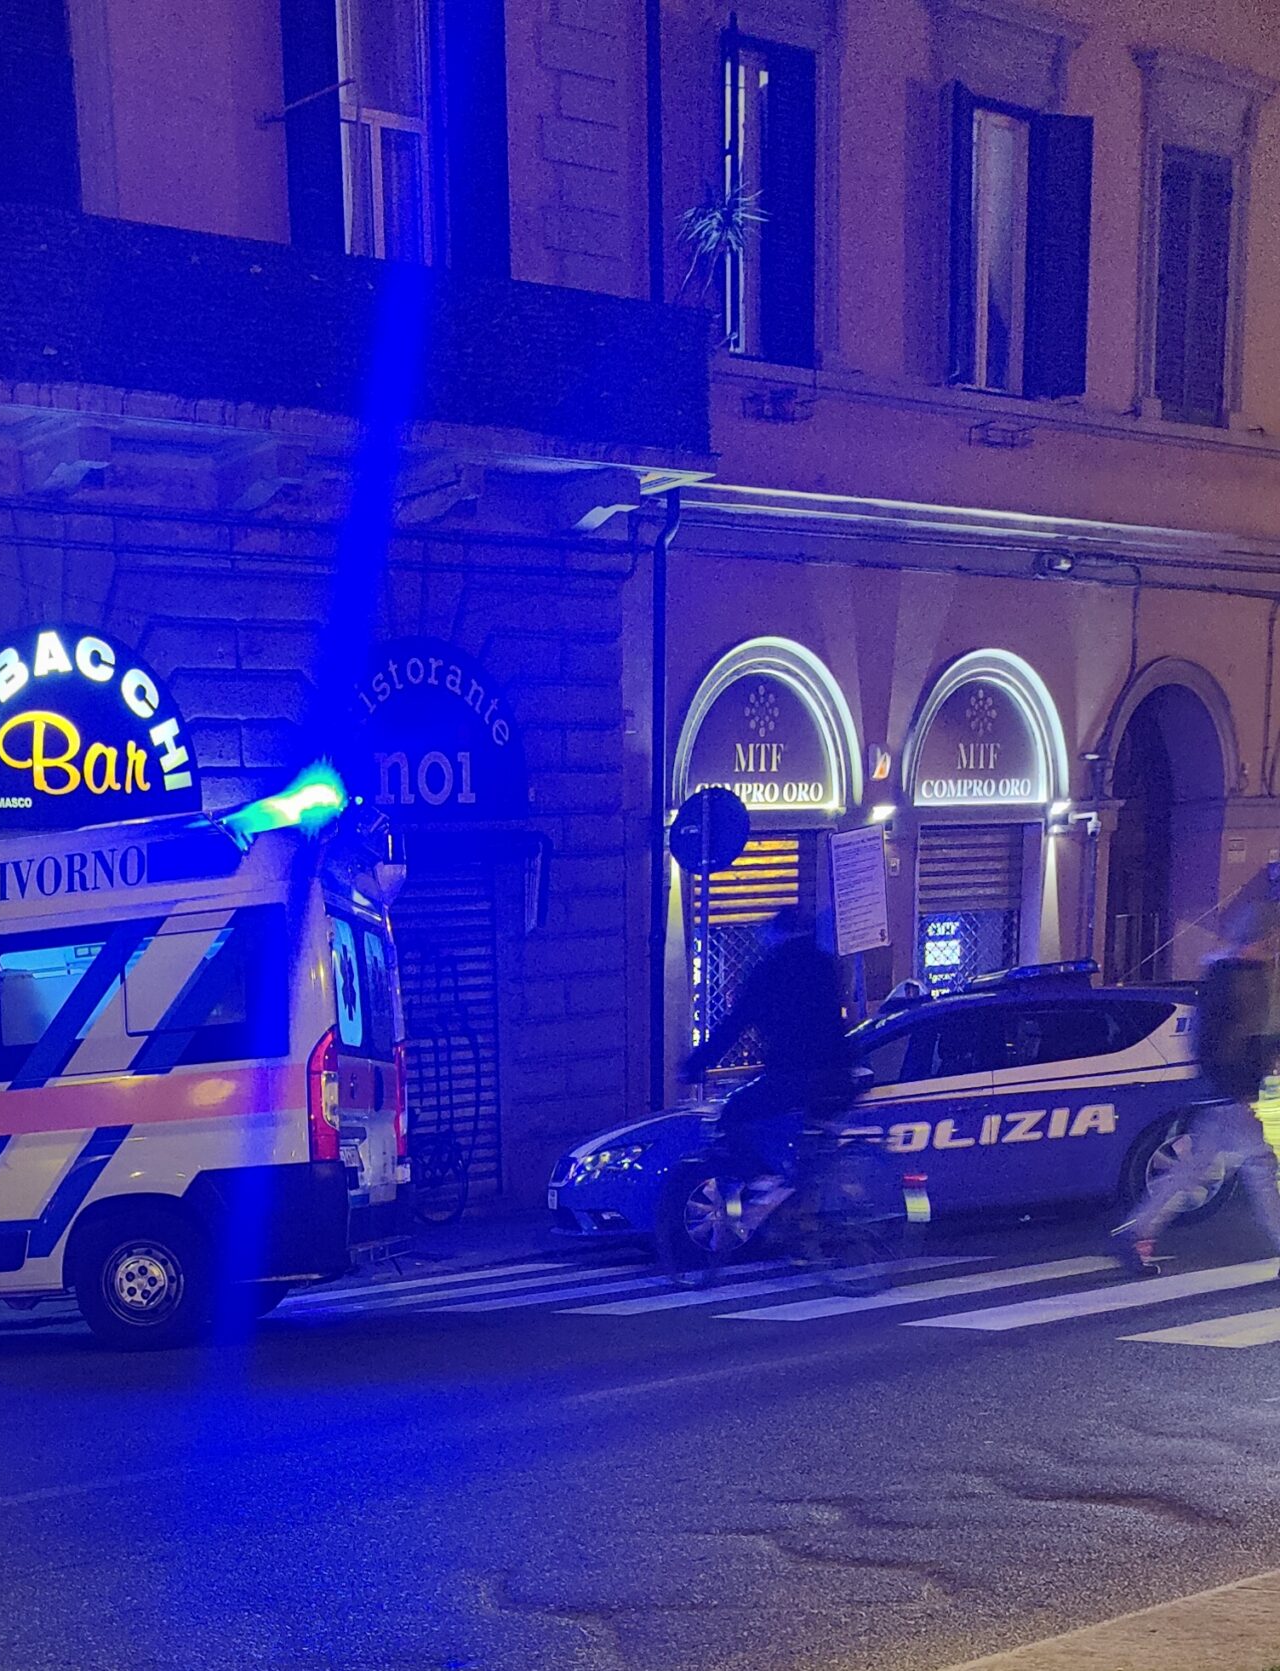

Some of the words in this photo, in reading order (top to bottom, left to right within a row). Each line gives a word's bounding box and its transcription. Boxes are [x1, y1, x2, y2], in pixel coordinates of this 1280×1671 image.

[734, 743, 784, 772] MTF
[956, 743, 1000, 769] MTF
[783, 783, 823, 802] ORO
[922, 779, 996, 798] COMPRO
[999, 778, 1031, 797] ORO
